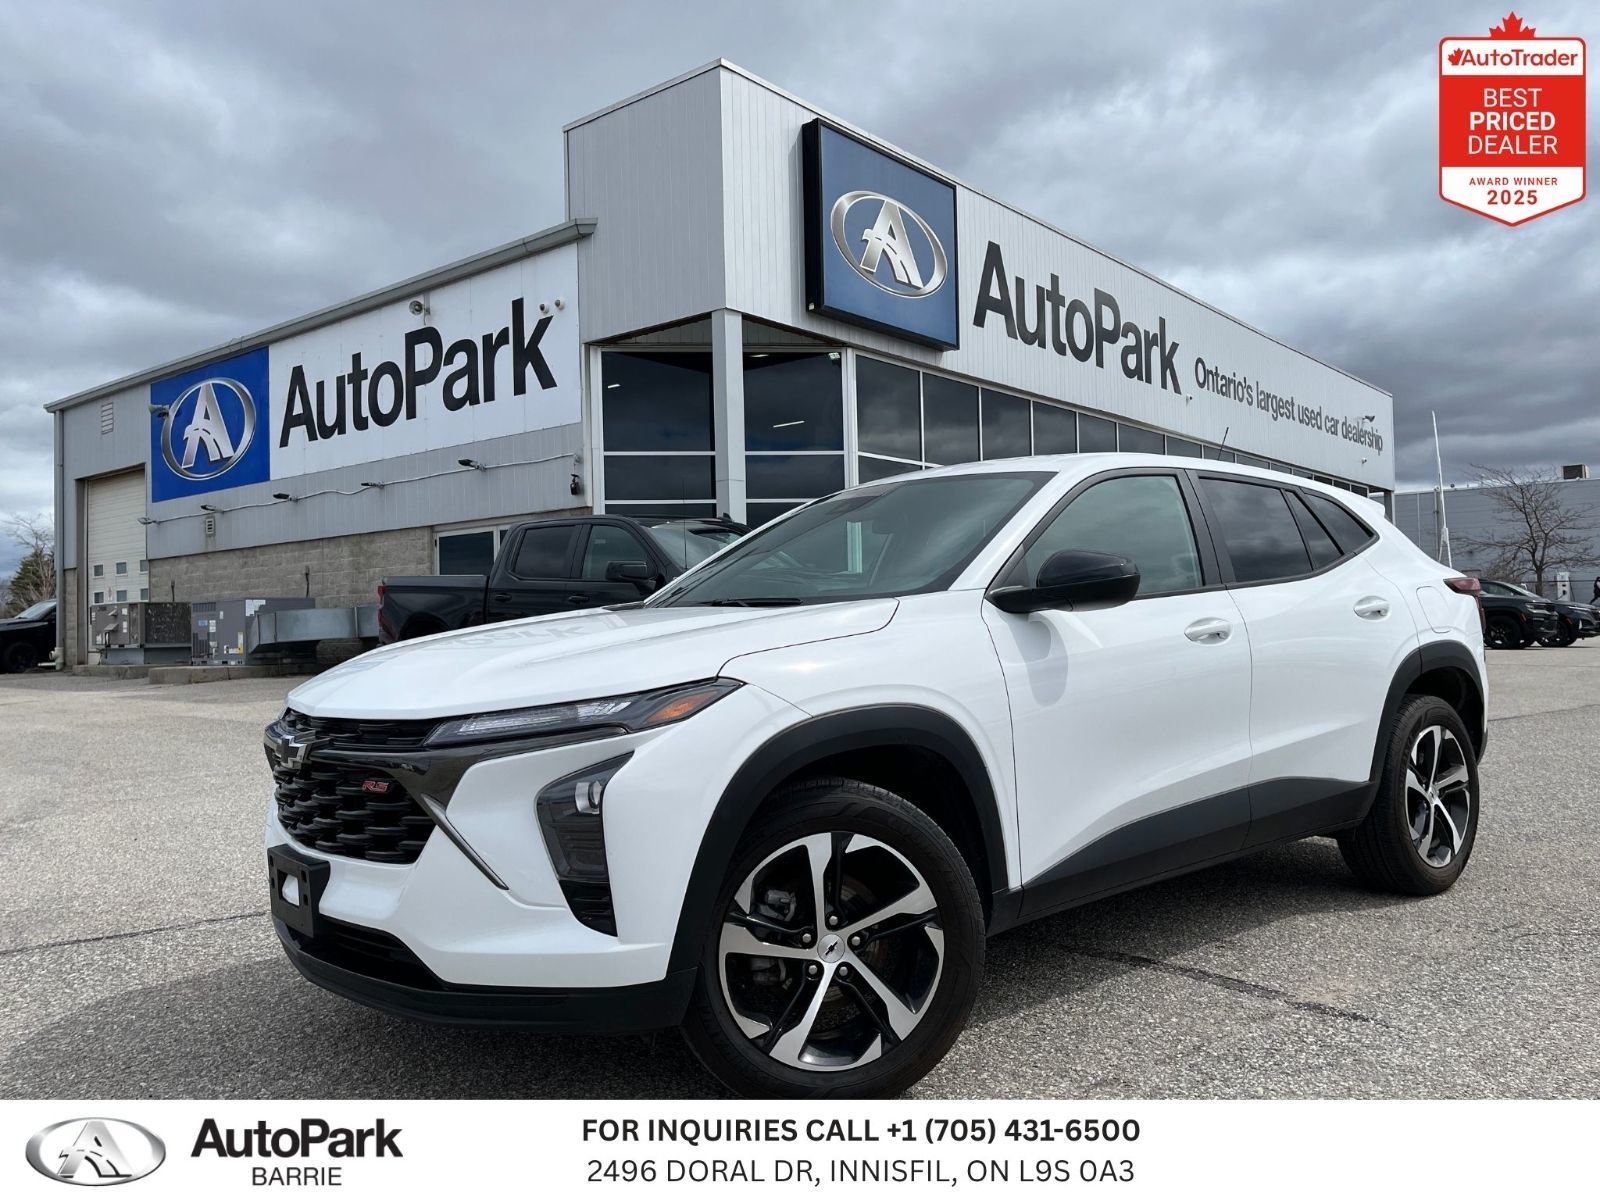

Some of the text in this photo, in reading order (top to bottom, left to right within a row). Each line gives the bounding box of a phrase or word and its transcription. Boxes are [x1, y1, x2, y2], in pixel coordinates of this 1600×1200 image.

[279, 297, 558, 449] AutoPark
[973, 240, 1182, 395] AutoPark
[1195, 357, 1383, 456] Ontario's largest used car dealership
[362, 780, 389, 792] RS
